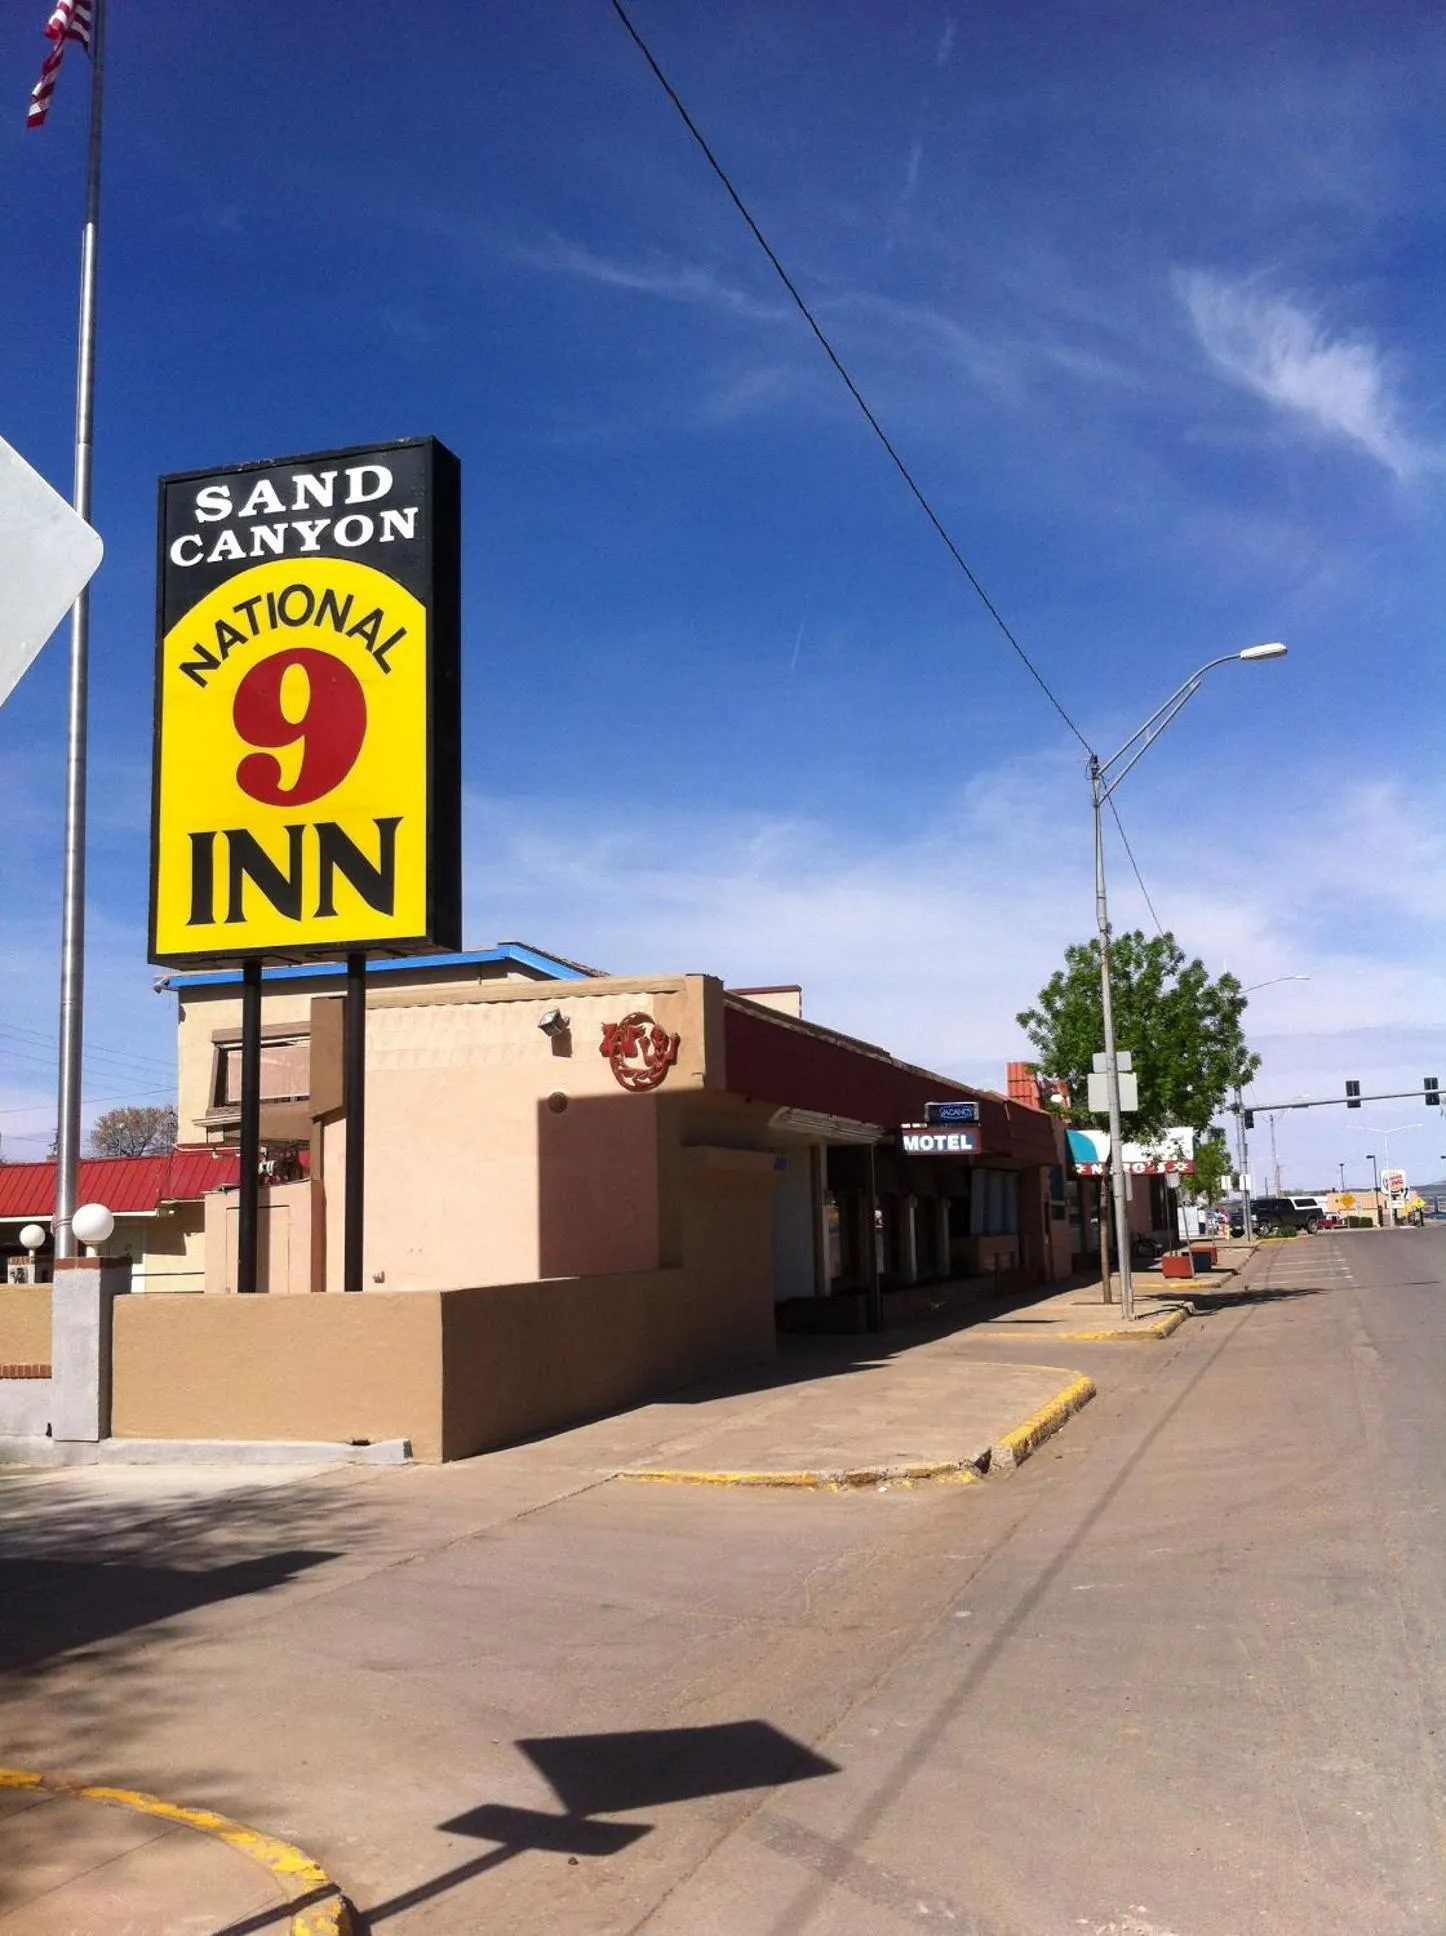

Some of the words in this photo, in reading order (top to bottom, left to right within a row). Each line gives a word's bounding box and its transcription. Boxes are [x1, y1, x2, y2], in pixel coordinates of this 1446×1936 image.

[195, 464, 394, 524] SAND
[169, 506, 419, 567] CANYON
[179, 583, 408, 688] NATIONAL
[232, 647, 368, 808] 9
[187, 816, 404, 926] INN
[903, 1133, 973, 1151] MOTEL
